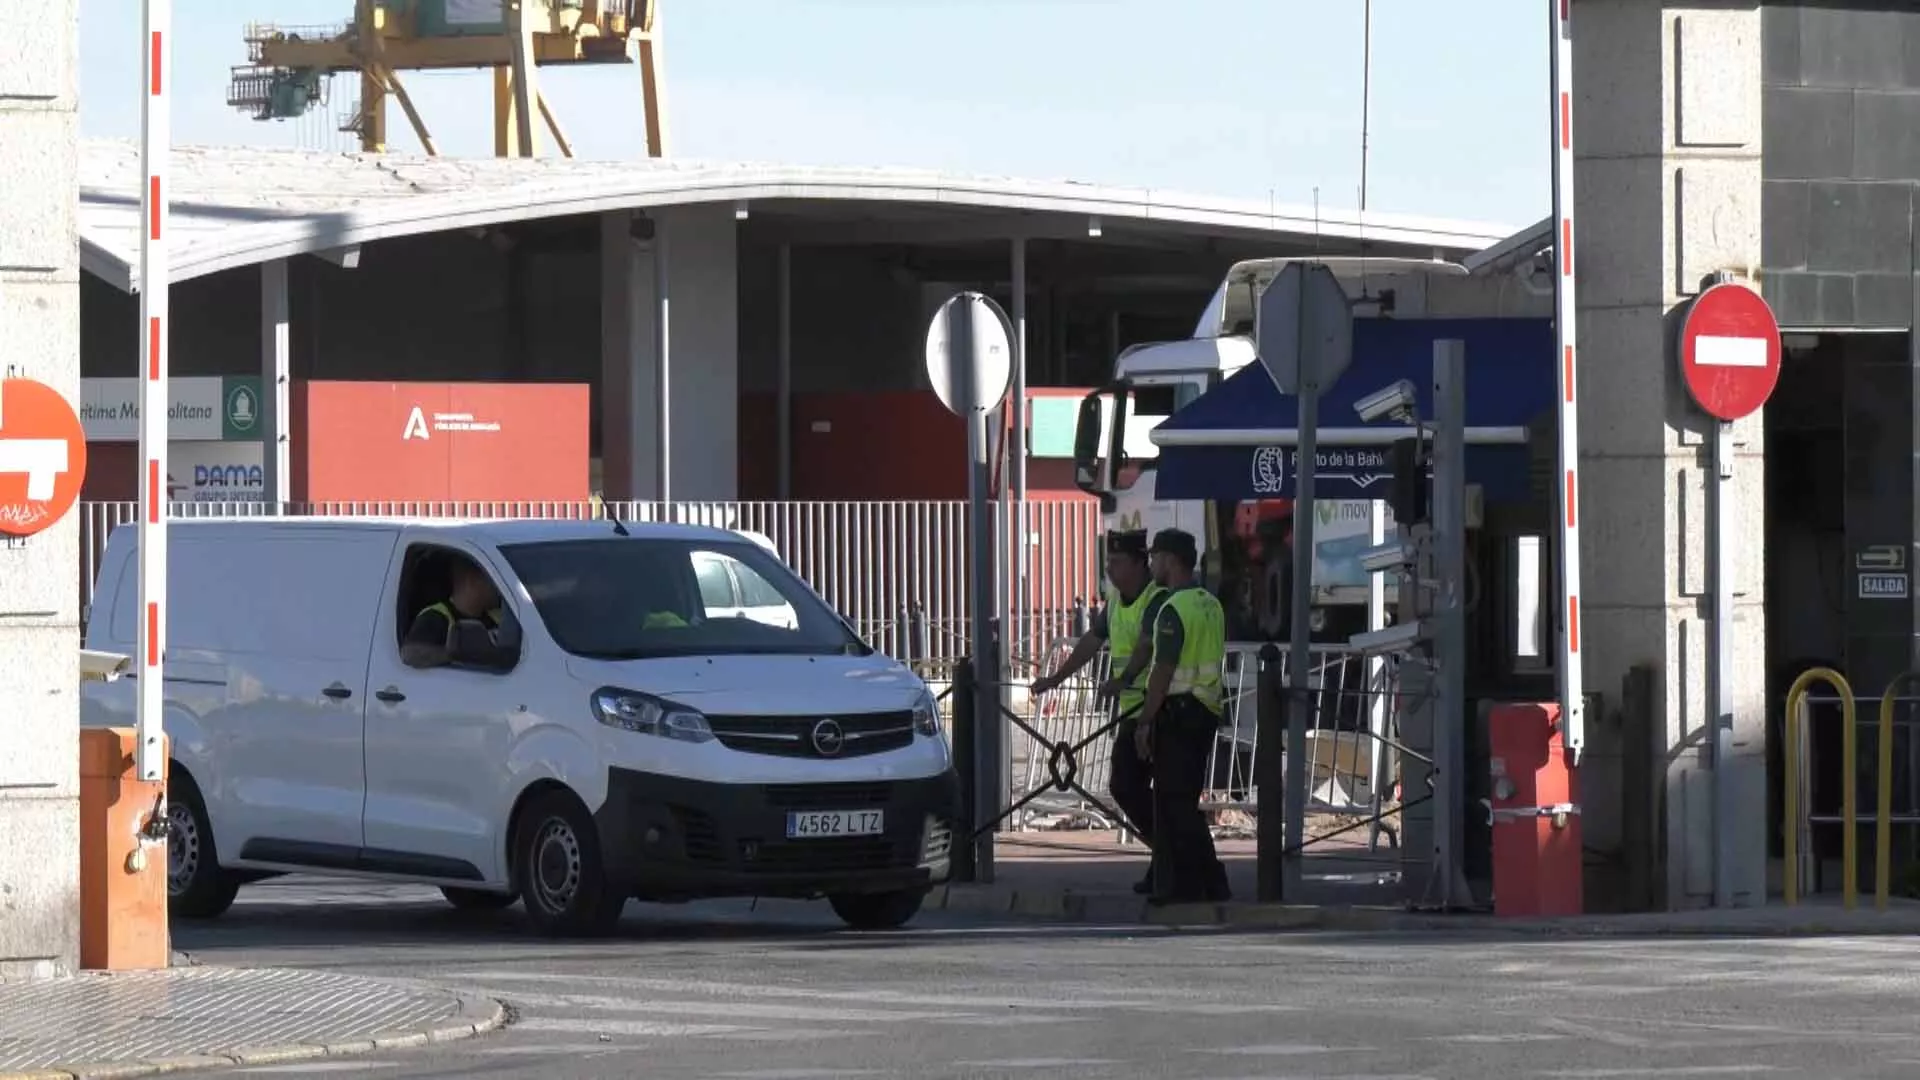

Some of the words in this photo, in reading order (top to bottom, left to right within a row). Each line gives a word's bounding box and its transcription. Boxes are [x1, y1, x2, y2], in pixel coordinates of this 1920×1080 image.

[1329, 449, 1343, 466] de
[1345, 451, 1354, 466] la
[194, 463, 263, 487] DAMA
[1863, 577, 1904, 593] SALIDA
[799, 814, 841, 834] 4562
[846, 812, 880, 833] LTZ
